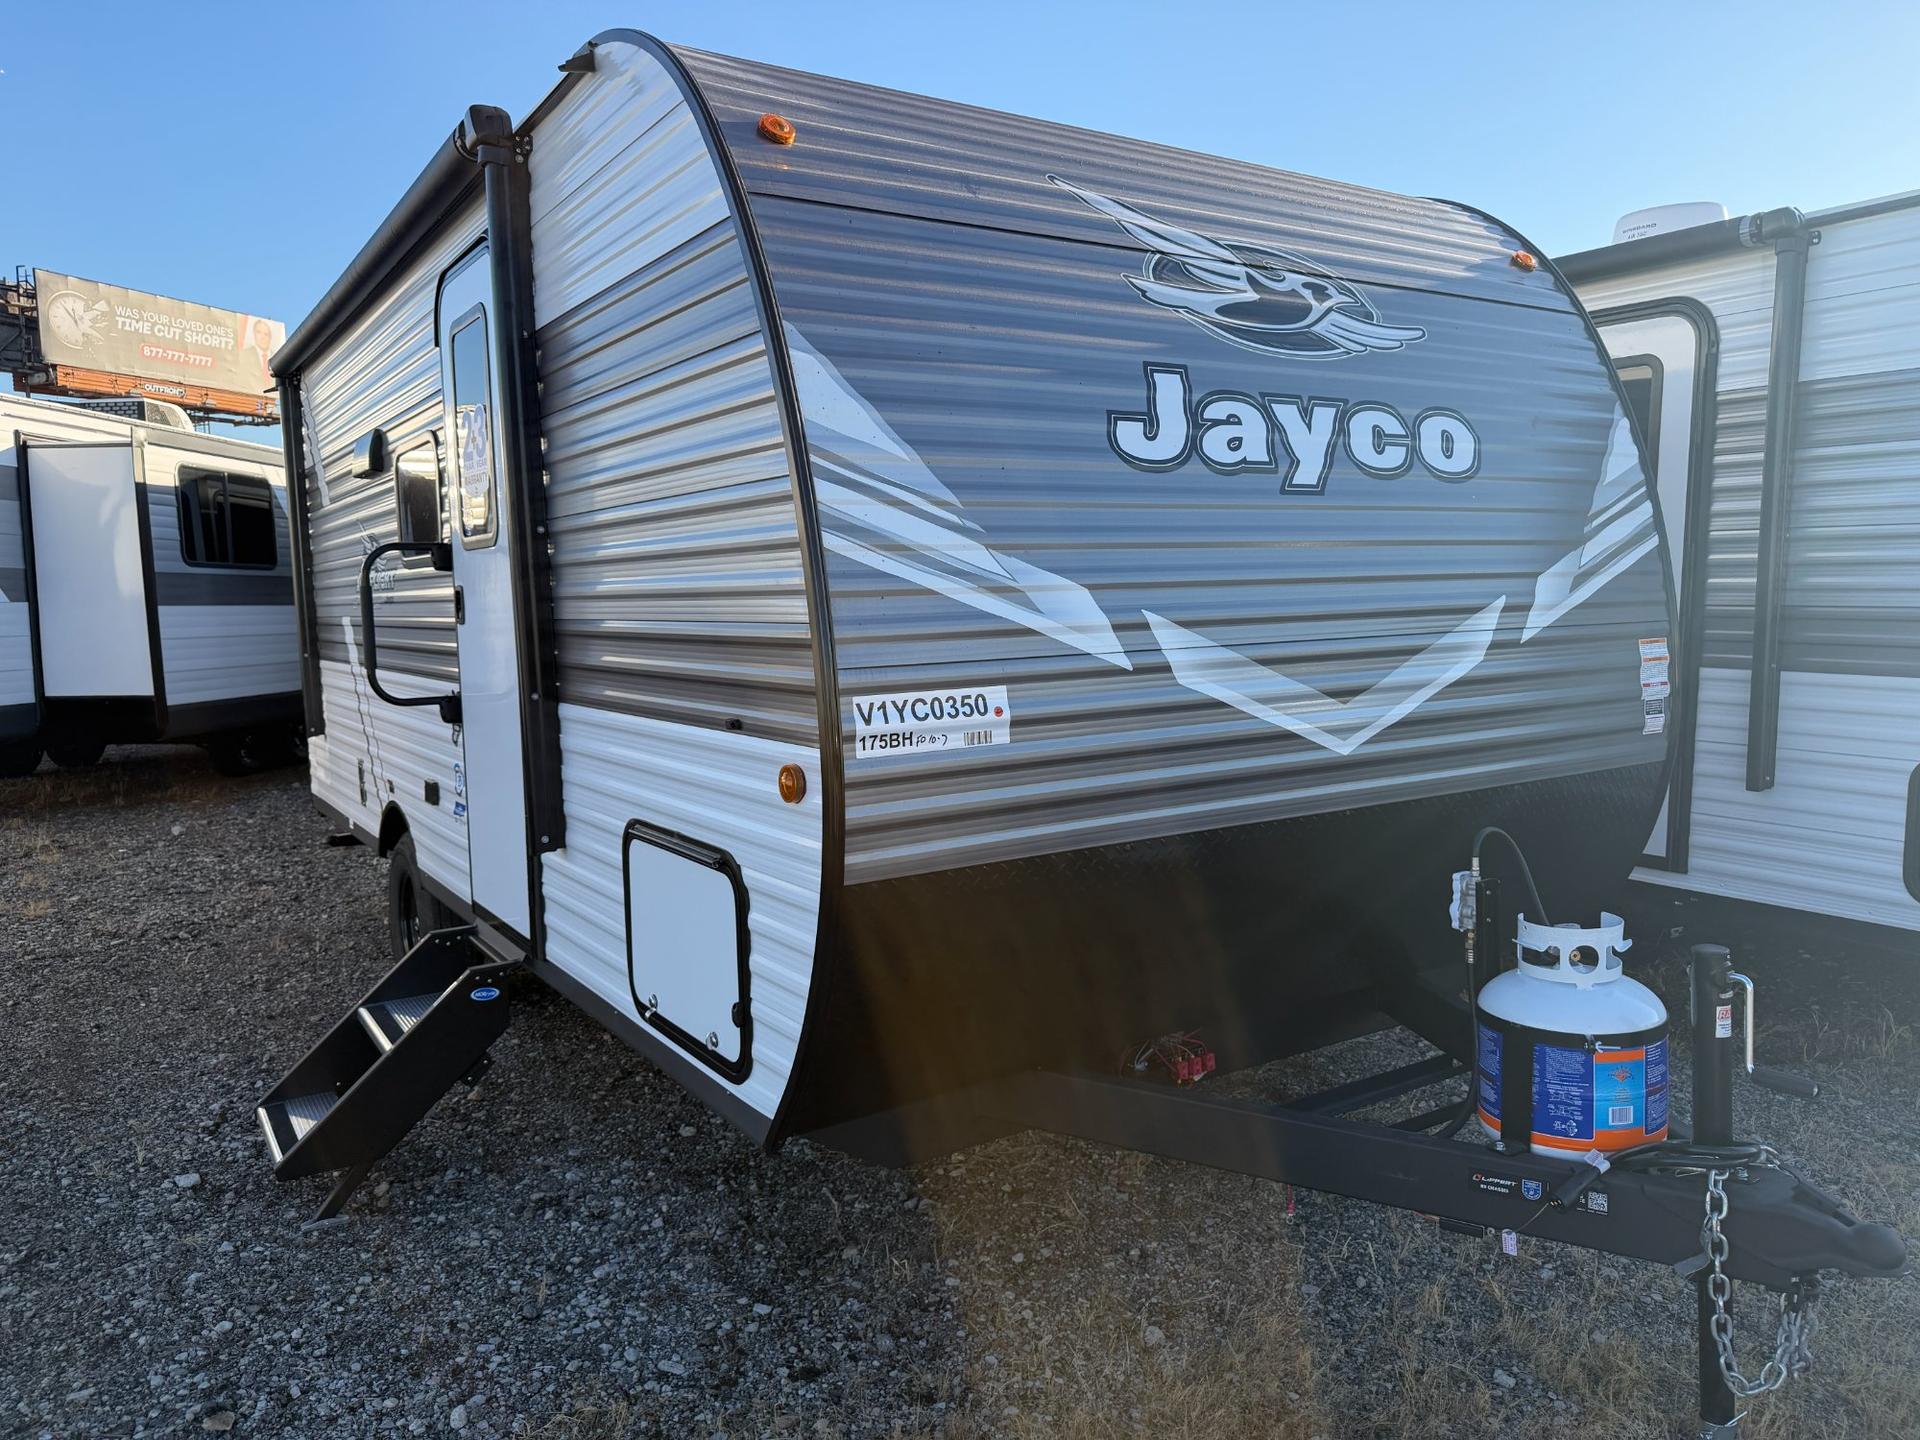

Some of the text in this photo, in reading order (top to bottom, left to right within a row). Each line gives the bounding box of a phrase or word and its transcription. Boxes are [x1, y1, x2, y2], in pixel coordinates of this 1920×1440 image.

[115, 306, 234, 338] WAS YOUR LOVED ONE'S
[115, 316, 234, 350] TIME CUT SHORT?
[143, 346, 212, 367] 877-777-7777
[1106, 361, 1482, 496] Jayco
[855, 693, 989, 727] V1YC0350
[859, 731, 913, 752] 175BH
